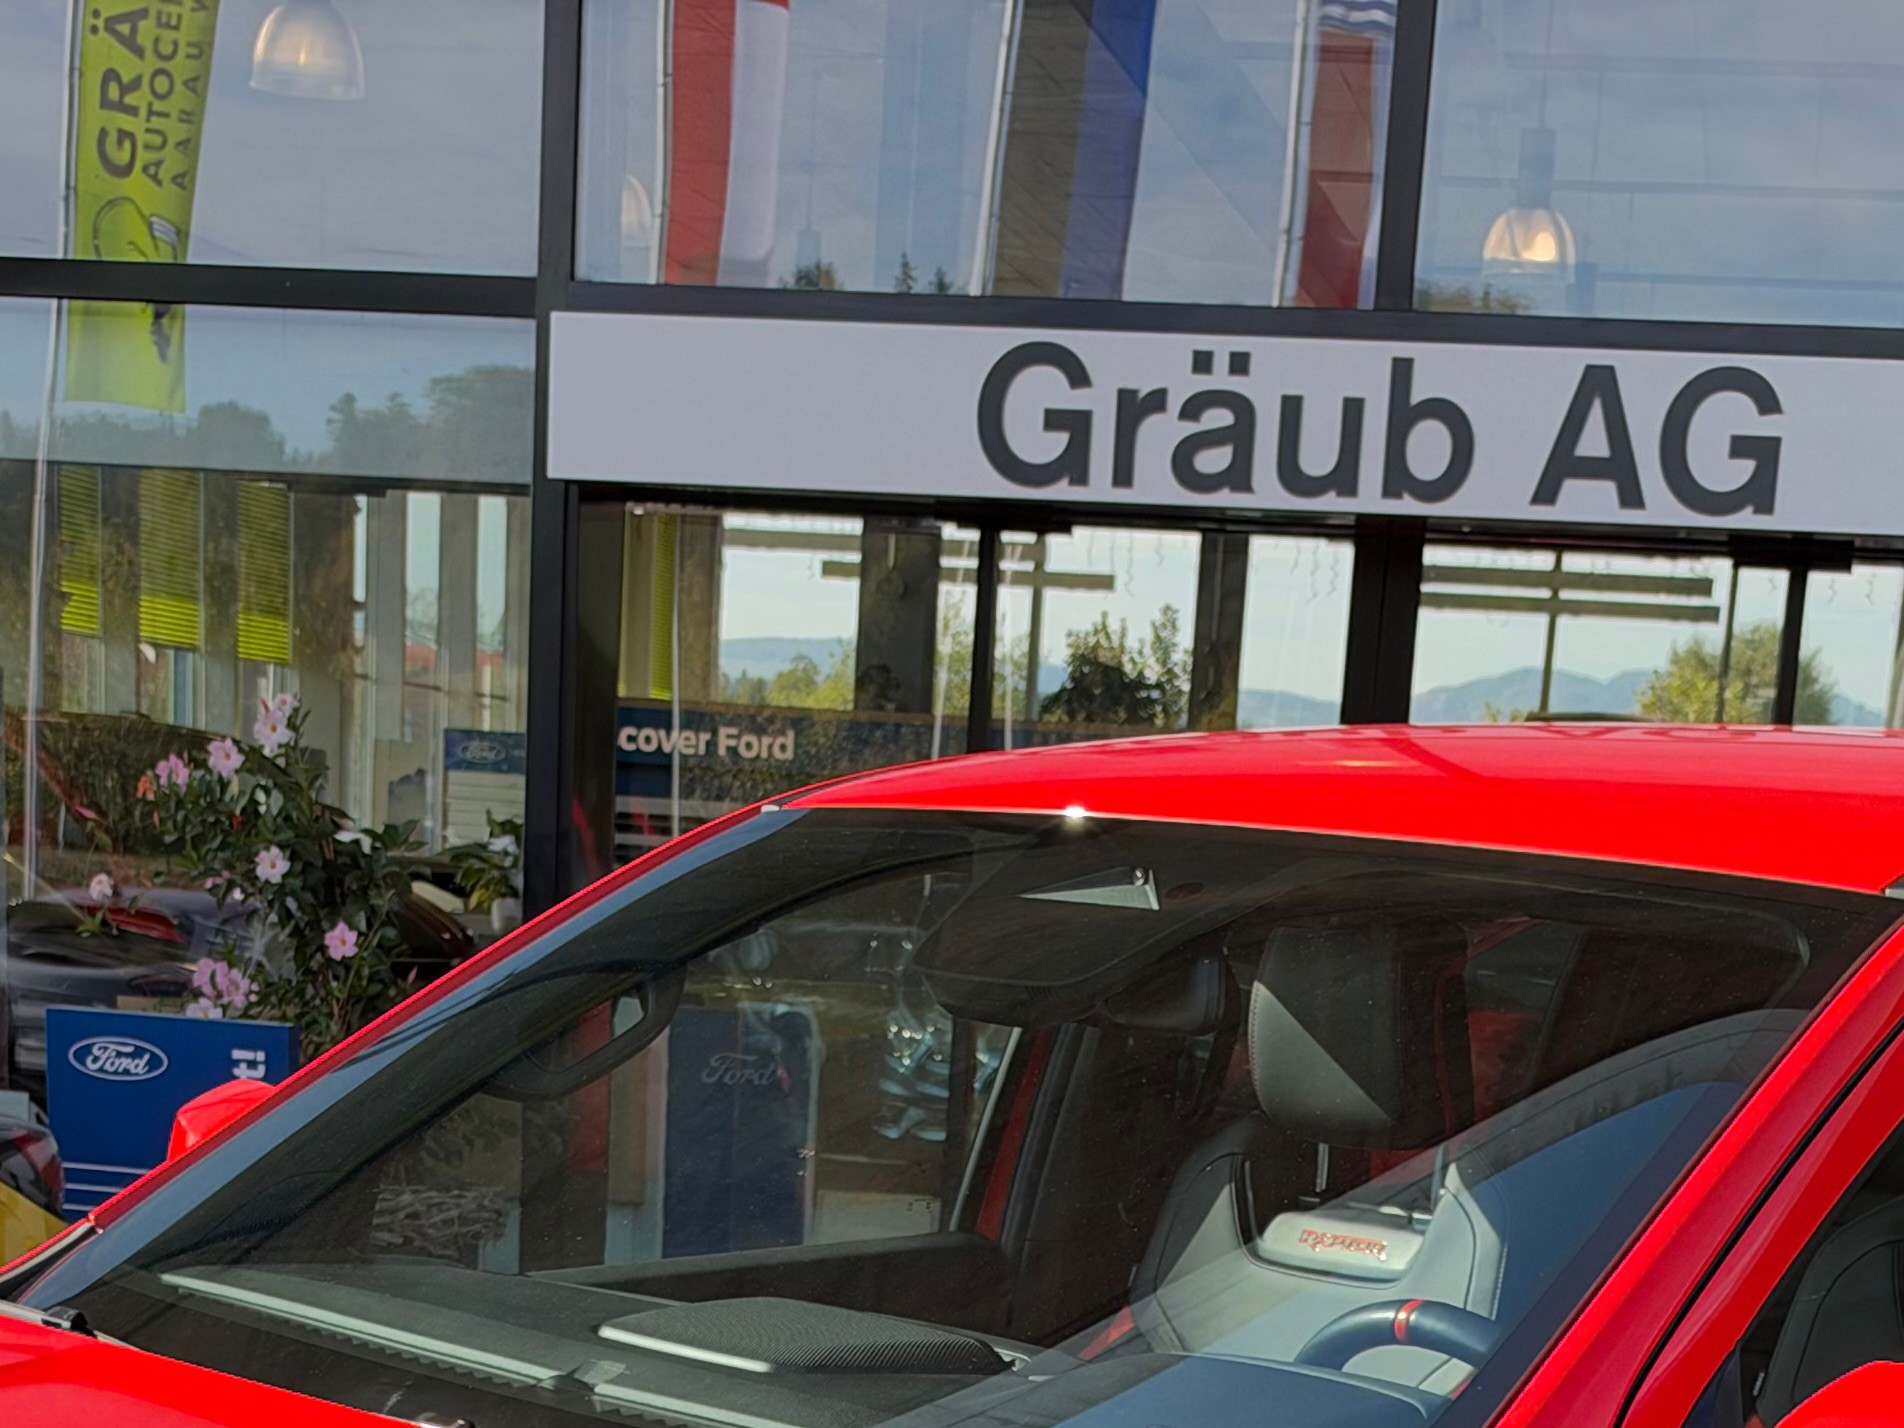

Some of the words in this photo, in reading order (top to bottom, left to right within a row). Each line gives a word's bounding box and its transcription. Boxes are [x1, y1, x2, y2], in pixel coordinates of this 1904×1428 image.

[141, 0, 184, 188] AUTOCE
[977, 340, 1475, 504] Gräub
[1529, 364, 1783, 517] AG
[616, 725, 713, 756] cover
[717, 726, 796, 761] Ford
[80, 1040, 156, 1079] Ford
[701, 1051, 778, 1086] Ford
